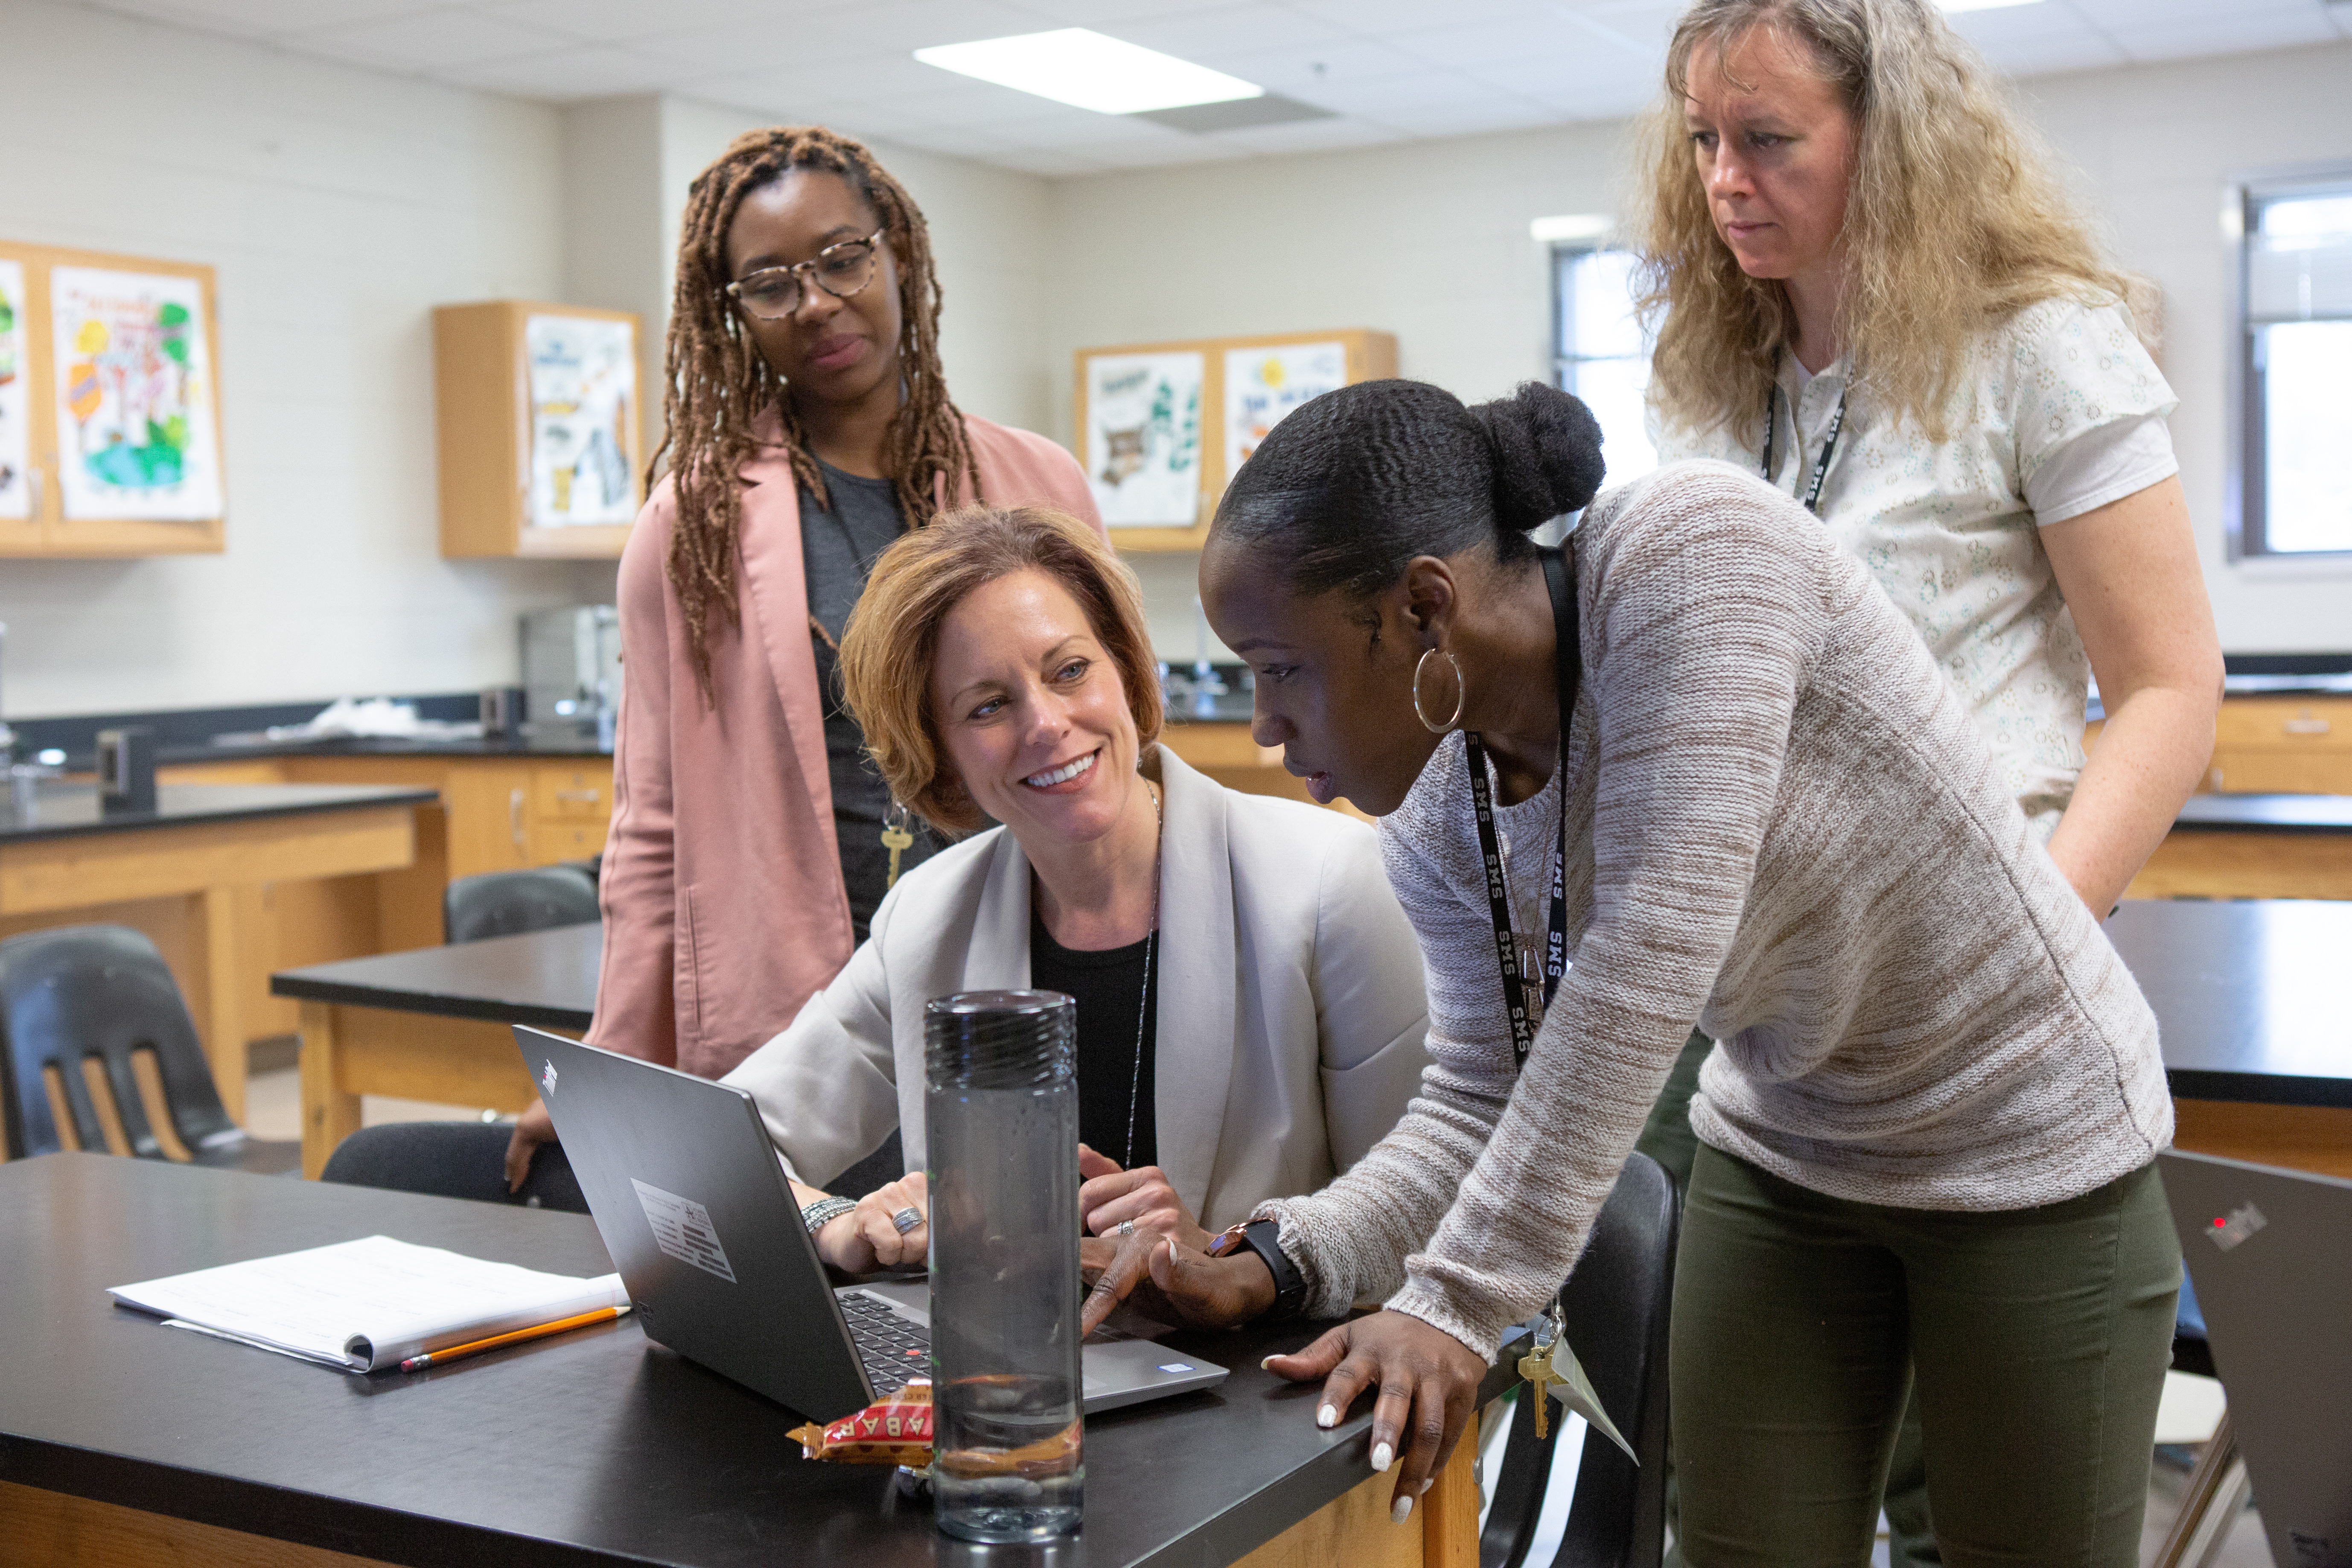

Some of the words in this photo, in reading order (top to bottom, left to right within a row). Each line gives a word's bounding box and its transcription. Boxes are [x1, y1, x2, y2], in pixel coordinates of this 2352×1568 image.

[1827, 408, 1843, 443] SMS
[1807, 465, 1824, 501] SMS
[1474, 778, 1490, 823] SMS
[1486, 854, 1503, 898] SMS
[1499, 930, 1516, 975] SMS
[1548, 931, 1562, 977] SMS
[1512, 1006, 1531, 1052] SMS
[838, 1416, 925, 1437] ABAR
